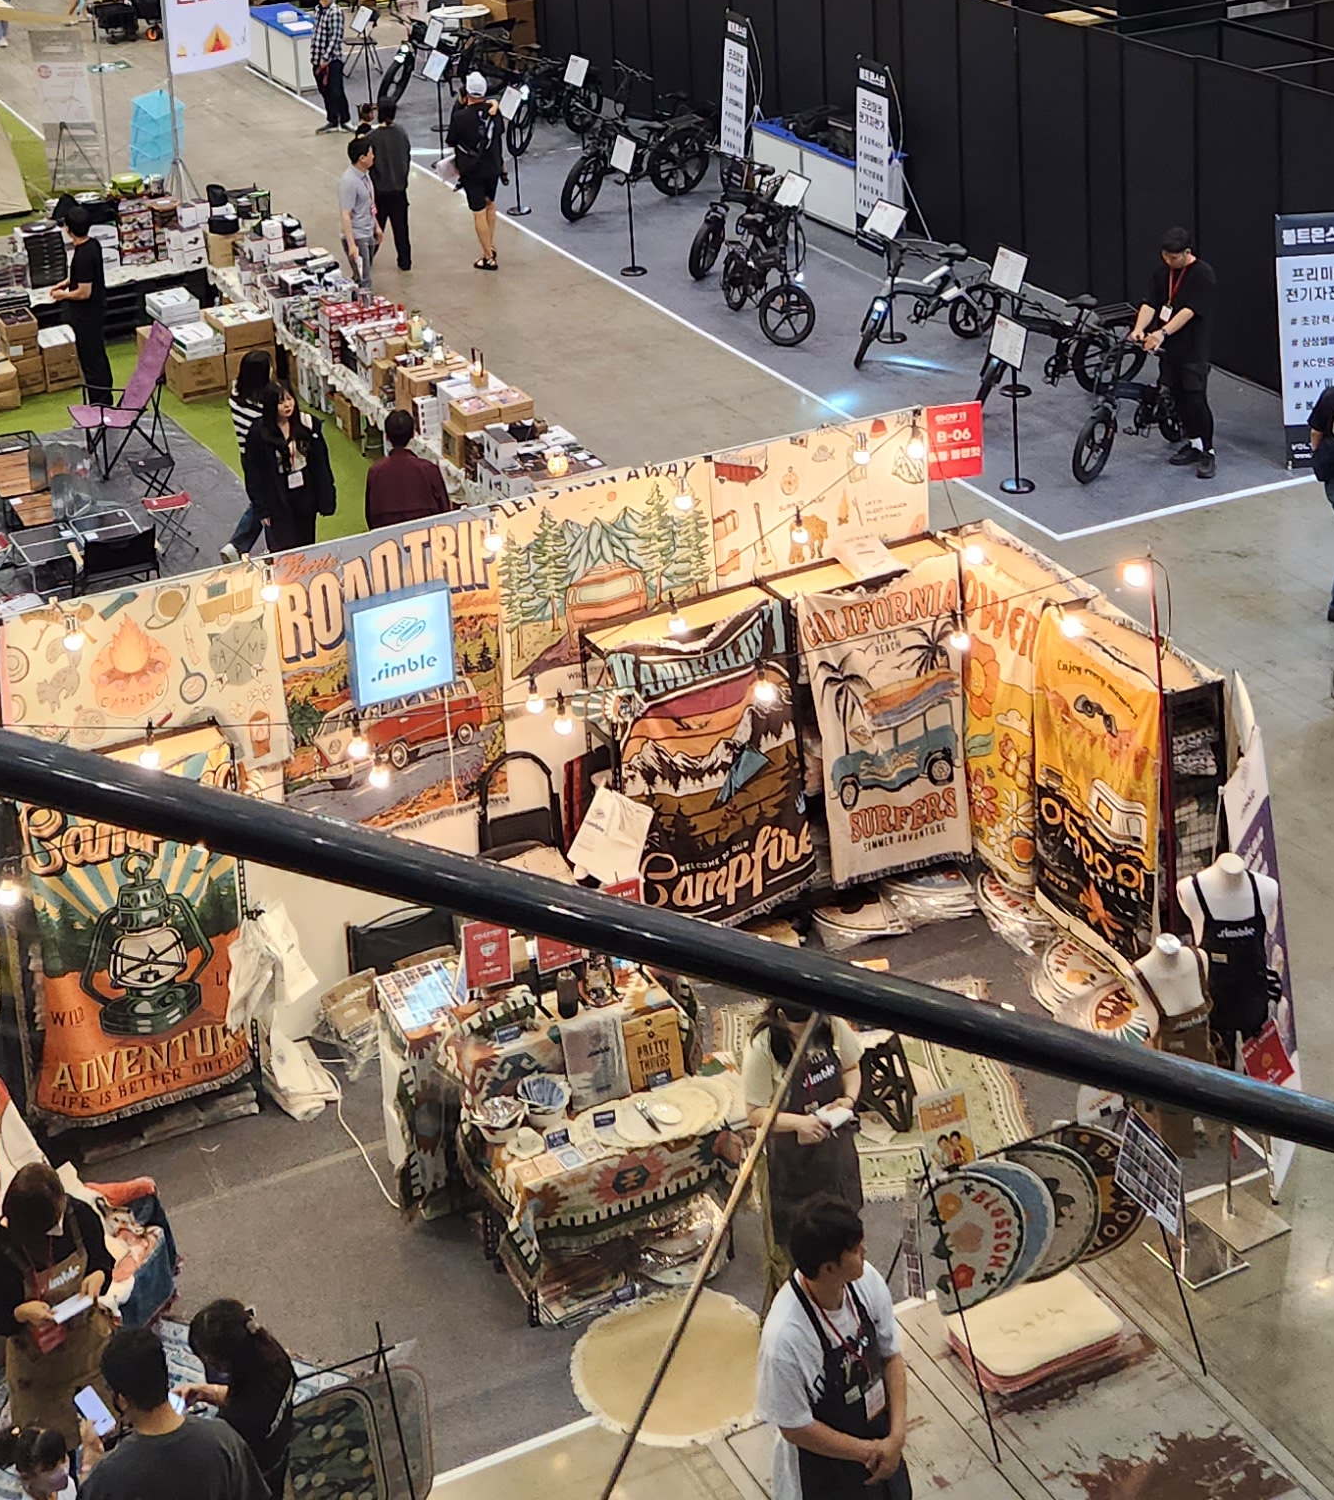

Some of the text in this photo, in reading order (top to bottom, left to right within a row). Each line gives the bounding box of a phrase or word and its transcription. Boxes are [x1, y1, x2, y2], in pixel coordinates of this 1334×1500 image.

[936, 428, 972, 443] B-06
[803, 579, 959, 648] CALIFORNIA
[875, 641, 902, 656] BEACH
[1057, 660, 1083, 676] Enjoy
[100, 683, 165, 709] CAMPING
[849, 787, 959, 844] SURFERS
[863, 834, 895, 852] SUMMER
[640, 820, 814, 907] Campfire
[51, 1007, 84, 1028] WILD
[636, 1039, 670, 1058] PRETTY
[638, 1054, 671, 1073] THINGS
[52, 1068, 182, 1109] LIFE IS BETTER
[971, 1189, 1012, 1269] BLOSSOM
